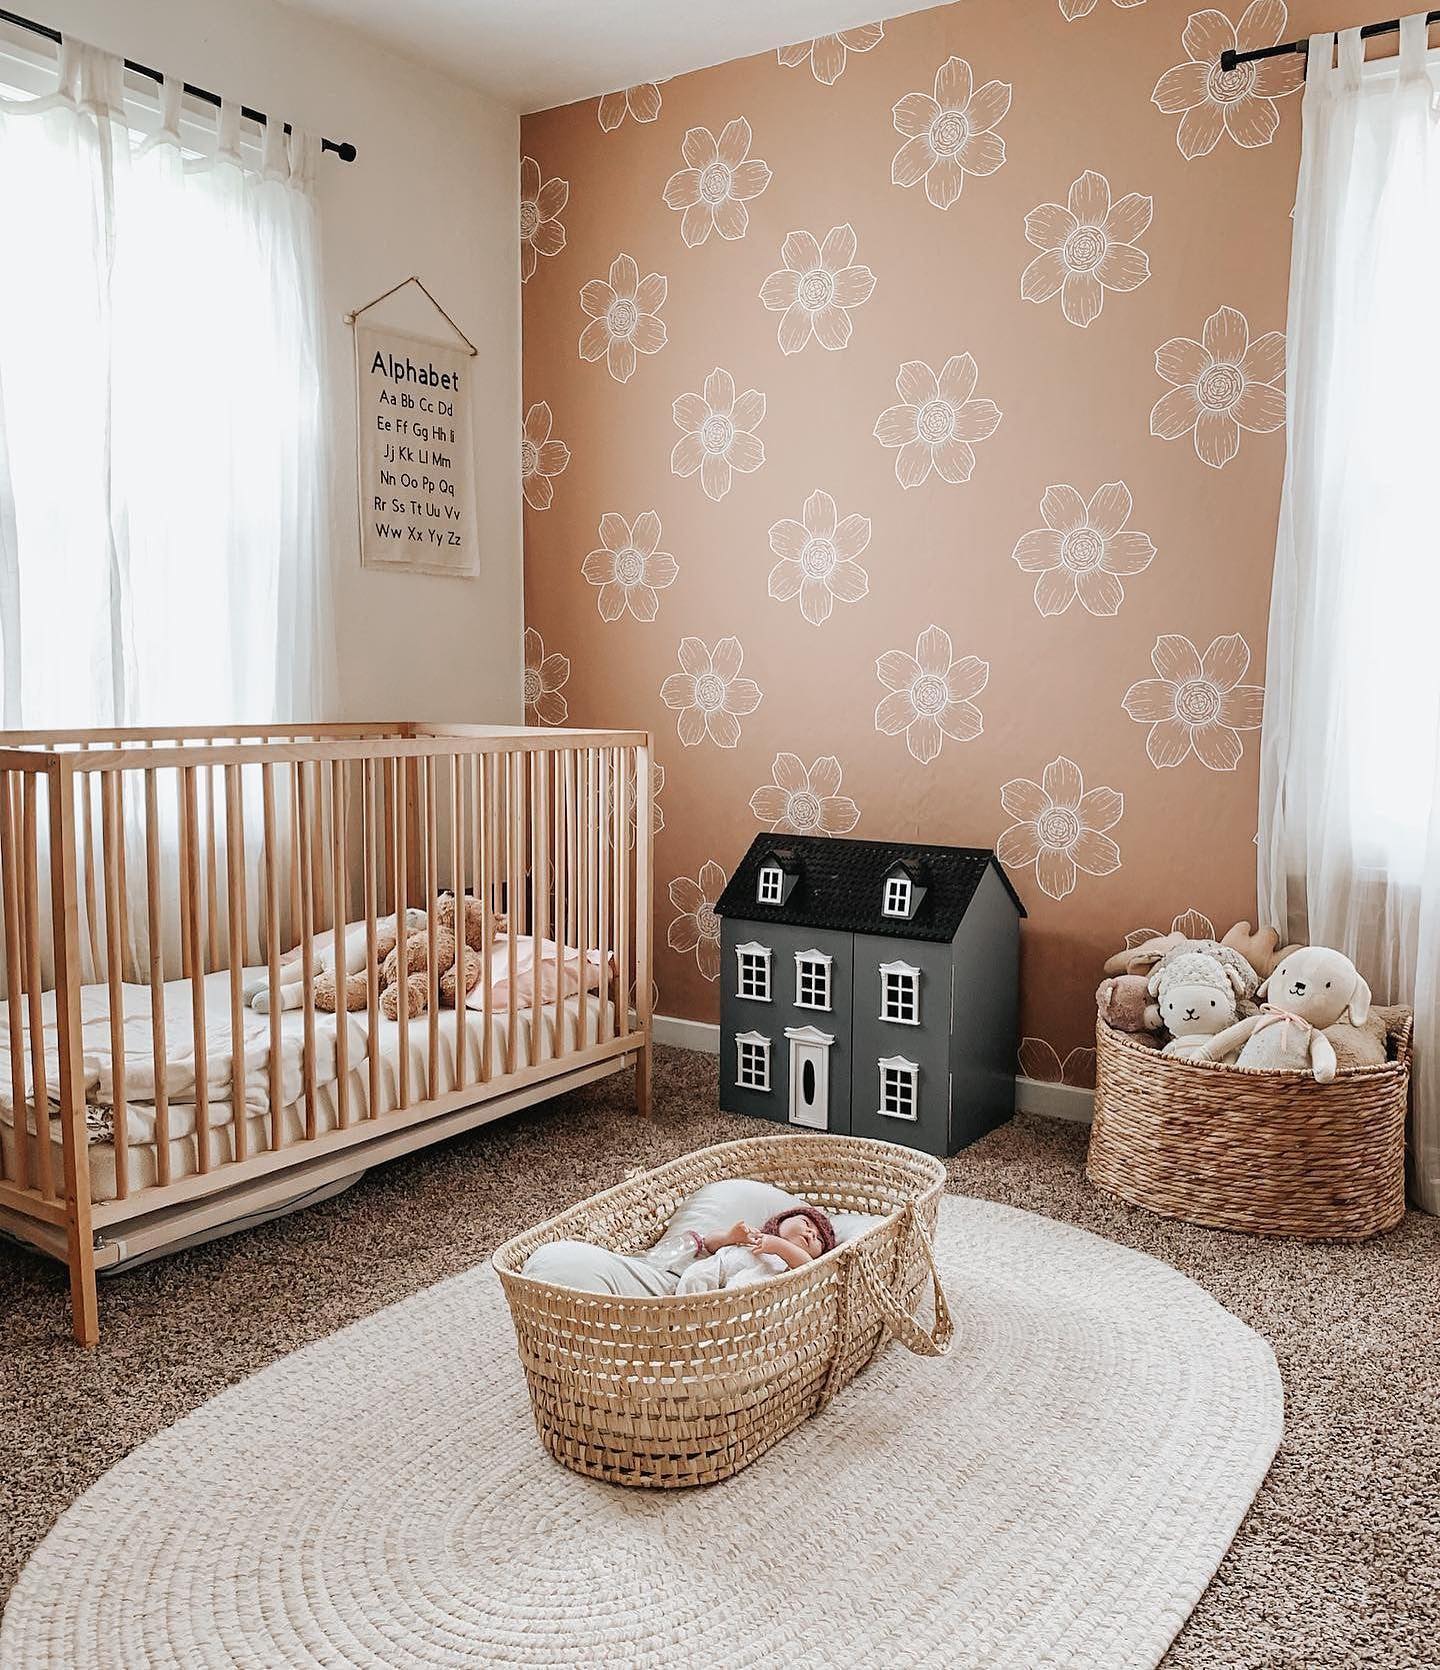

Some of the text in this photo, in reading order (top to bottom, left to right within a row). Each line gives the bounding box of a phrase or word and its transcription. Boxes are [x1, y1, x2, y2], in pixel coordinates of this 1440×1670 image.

[371, 351, 459, 392] Alphabet
[379, 390, 453, 417] Aa Bb Cc Dd
[377, 416, 391, 431] Ee
[396, 419, 408, 434] Ff
[412, 423, 429, 441] Gg
[432, 426, 446, 441] Hh
[384, 444, 395, 462] Jj
[399, 446, 414, 462] Kk
[432, 452, 451, 468] Mm
[380, 470, 455, 497] Nn Oo Pp Qq
[374, 496, 460, 520] Rr Ss Tt Uu Vv
[376, 523, 461, 546] Ww Xx Yy Zz
